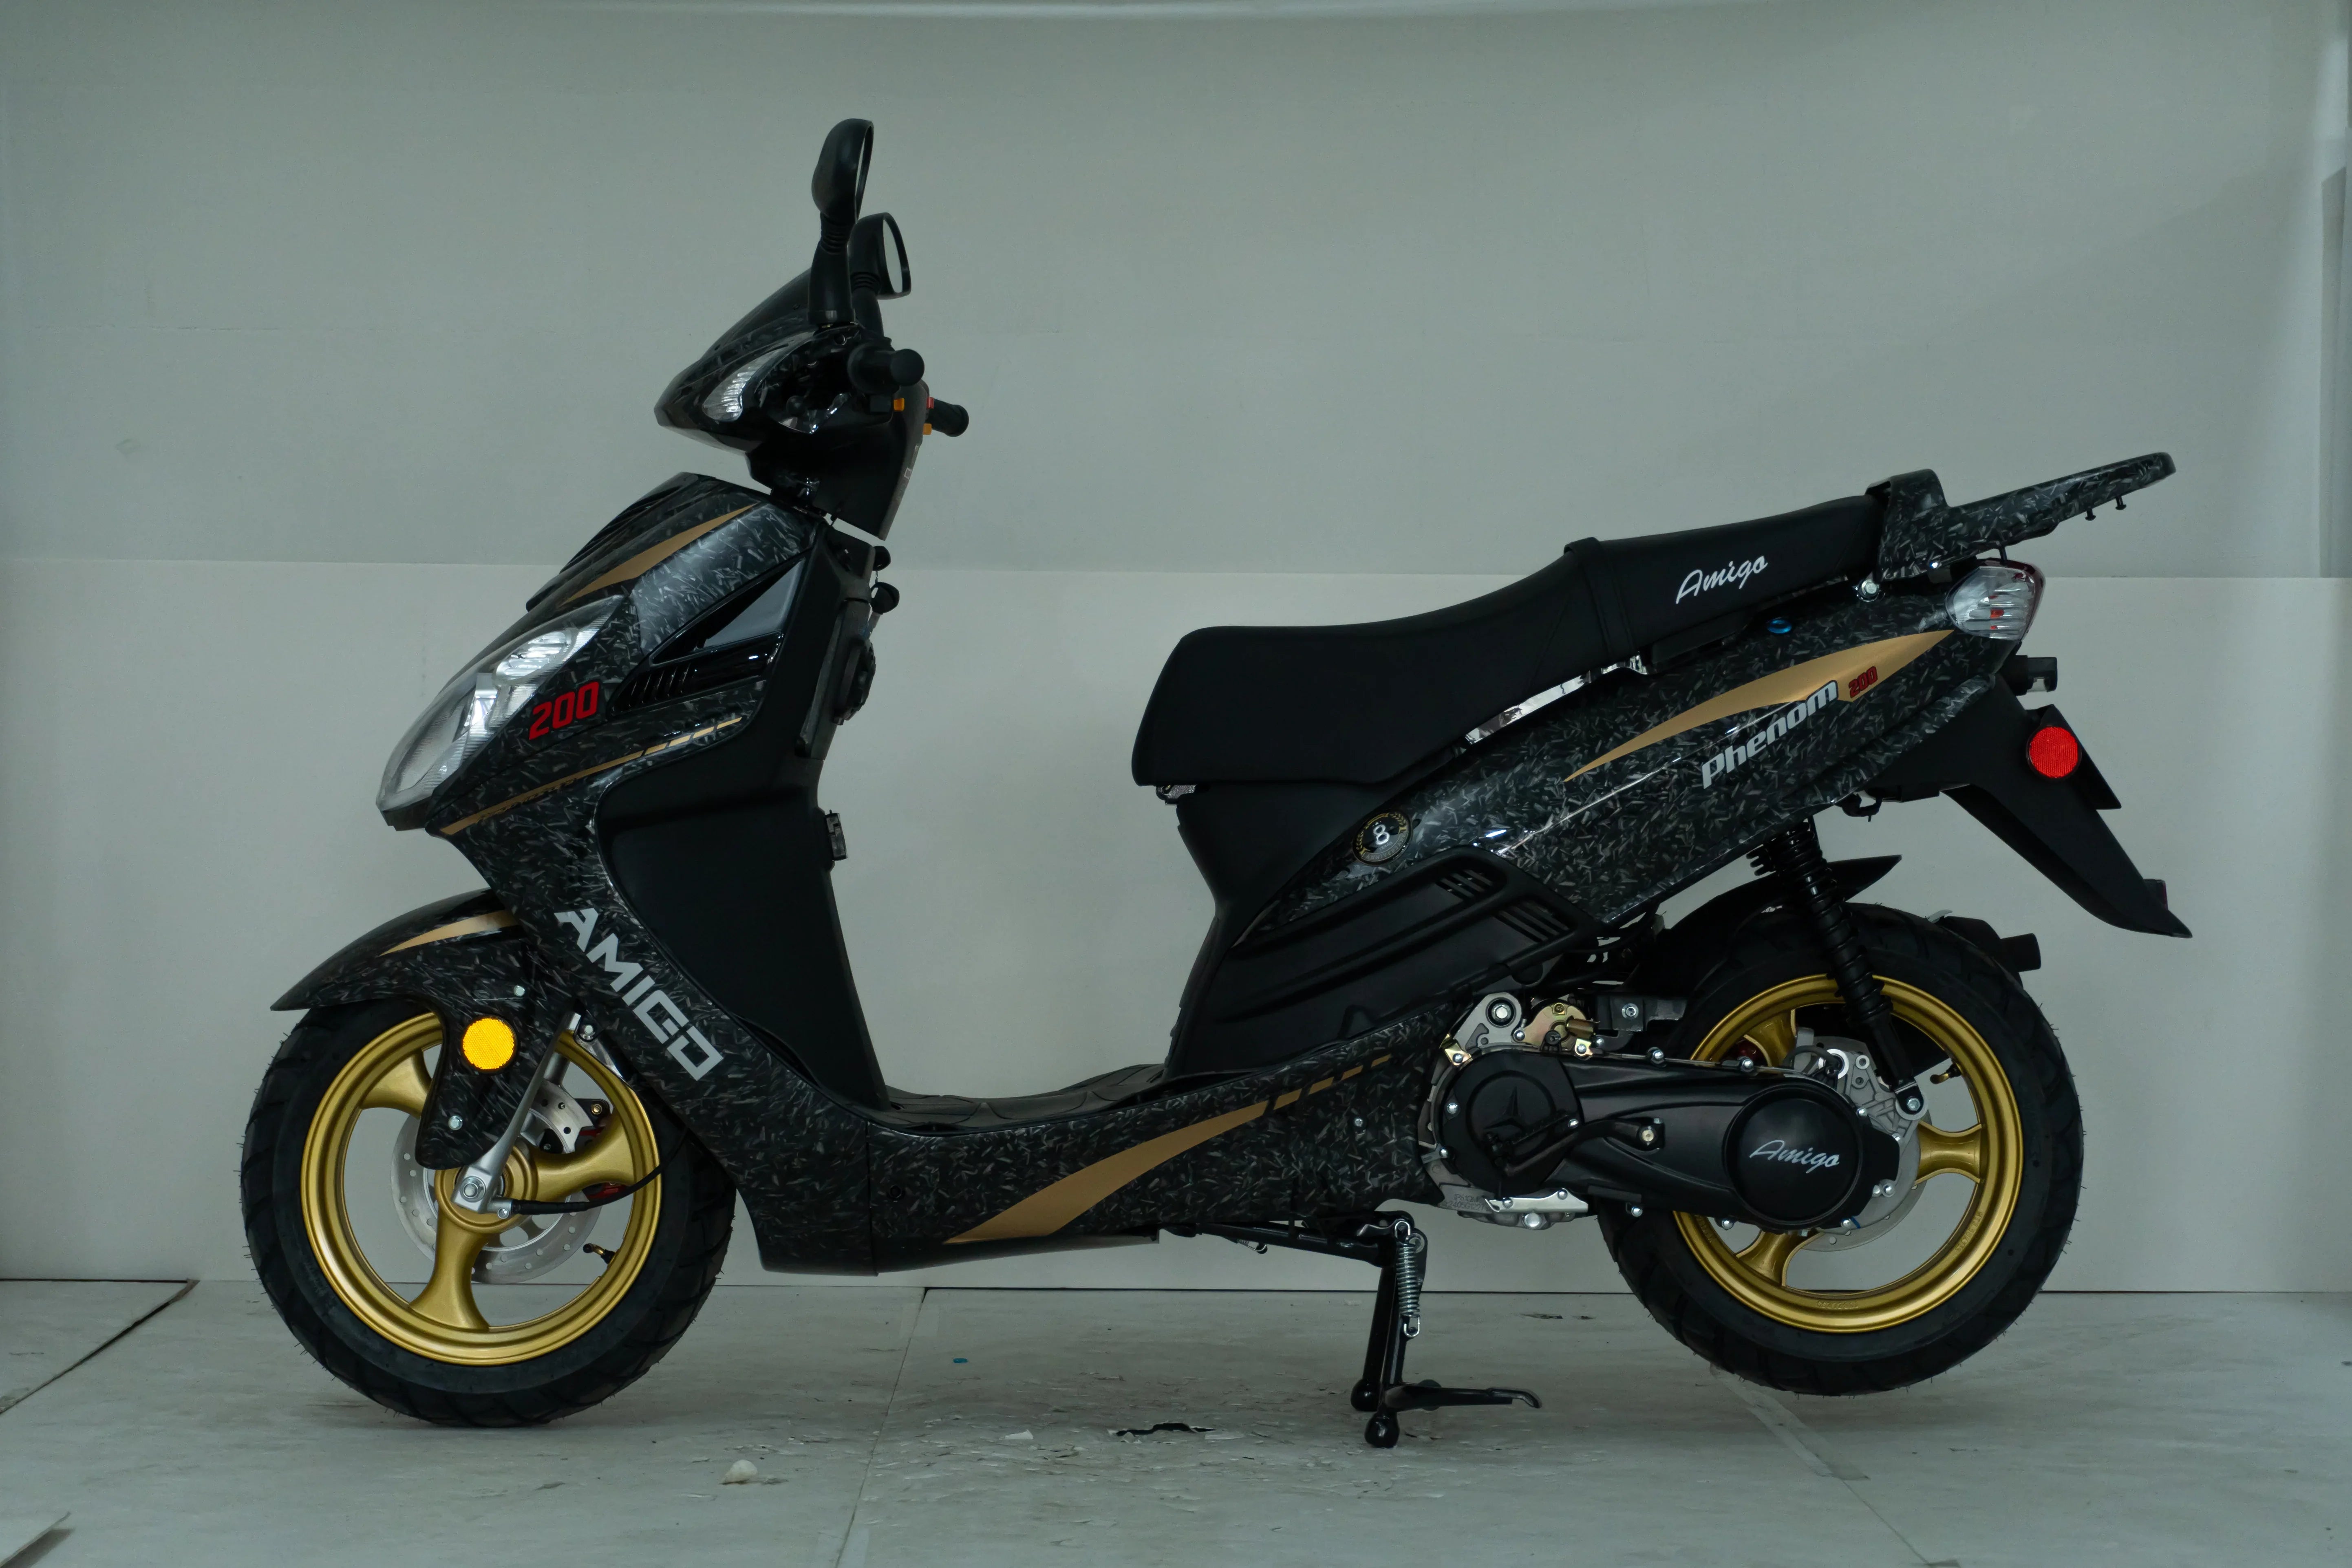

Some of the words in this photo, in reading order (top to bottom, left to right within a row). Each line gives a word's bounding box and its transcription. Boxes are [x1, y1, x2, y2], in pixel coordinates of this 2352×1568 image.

[1675, 555, 1768, 604] Amigo
[1849, 666, 1878, 698] 200
[529, 681, 599, 740] 200
[1373, 824, 1390, 846] 8
[554, 907, 724, 1081] AMIGO
[1749, 1140, 1840, 1173] Amigo
